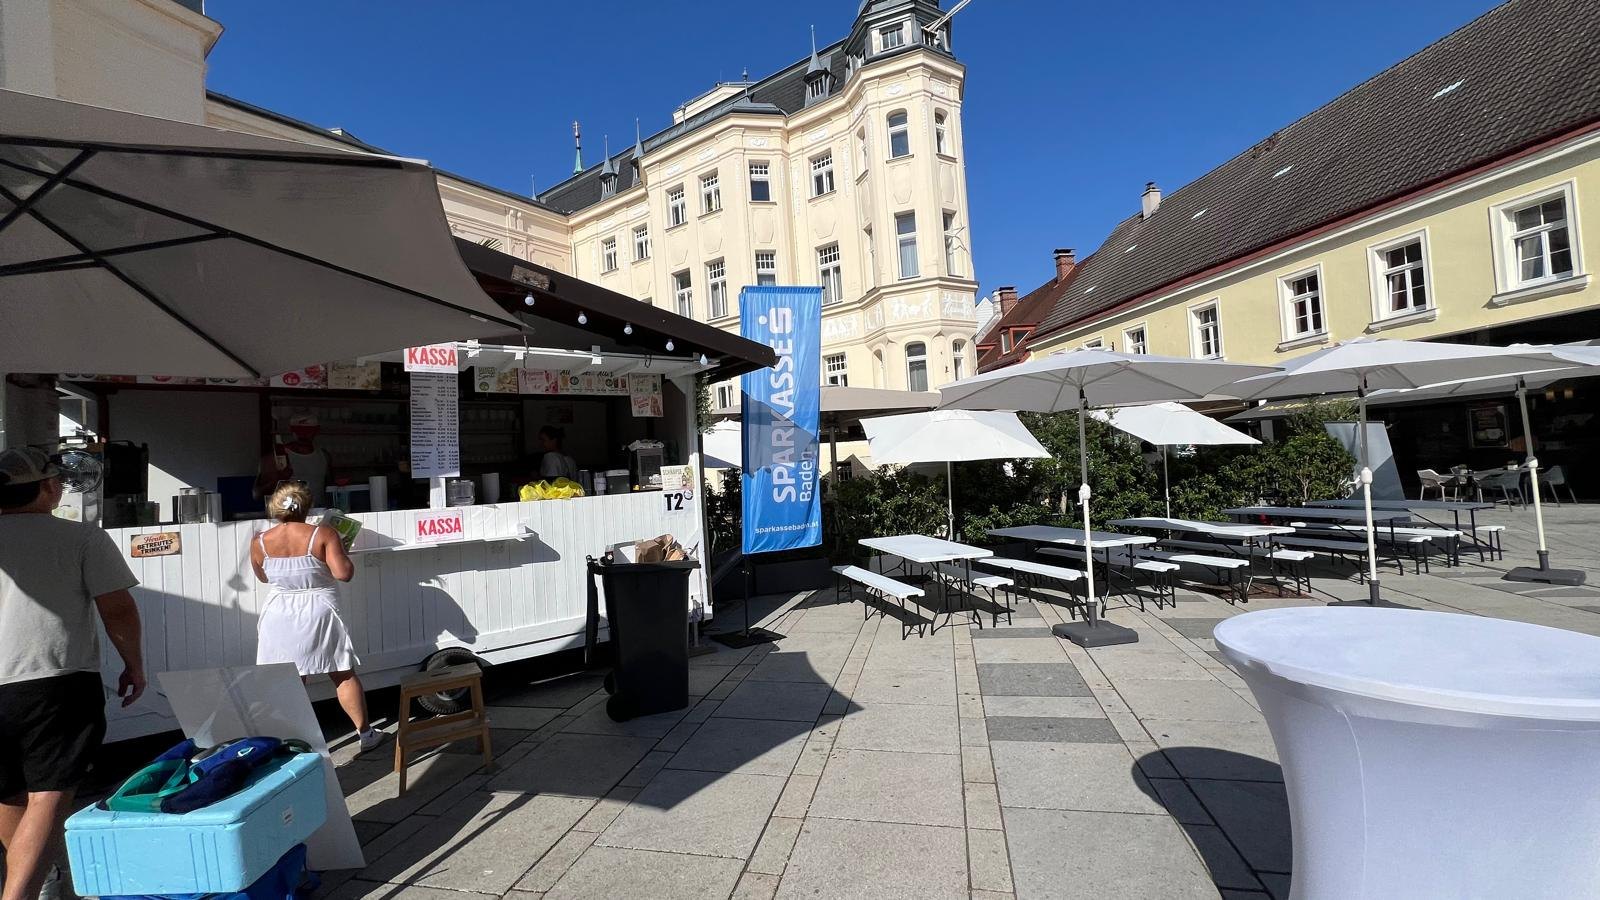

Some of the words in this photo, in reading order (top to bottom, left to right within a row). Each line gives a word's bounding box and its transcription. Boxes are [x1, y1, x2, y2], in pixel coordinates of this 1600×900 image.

[408, 346, 457, 367] KASSA
[770, 340, 797, 503] SPARKASSE
[799, 450, 814, 502] Baden
[664, 492, 684, 511] T2
[418, 517, 462, 536] KASSA
[137, 539, 173, 550] BETREUTES
